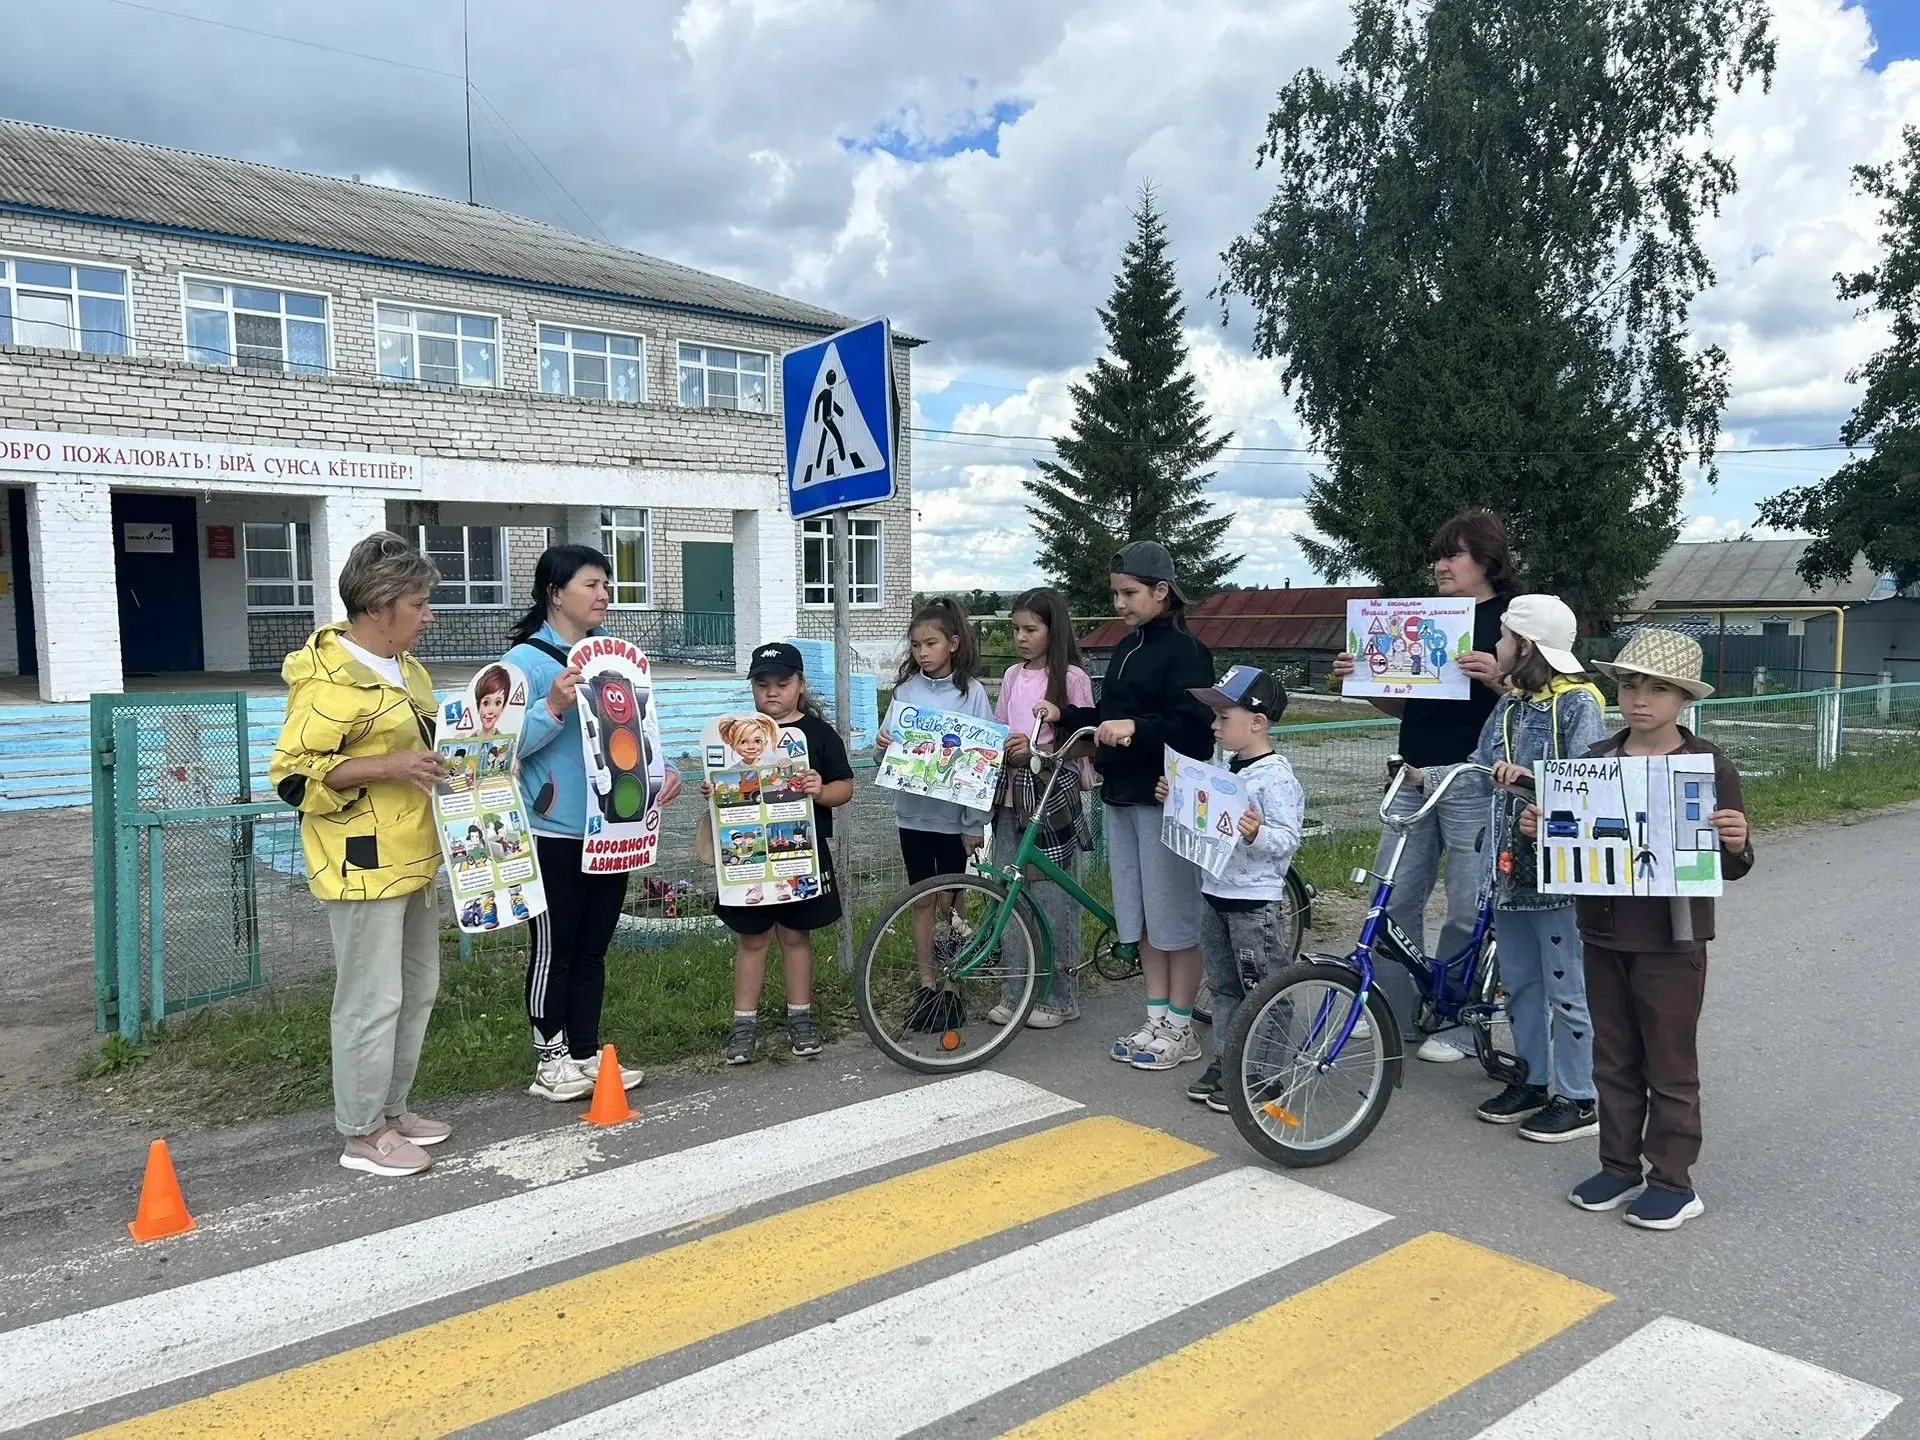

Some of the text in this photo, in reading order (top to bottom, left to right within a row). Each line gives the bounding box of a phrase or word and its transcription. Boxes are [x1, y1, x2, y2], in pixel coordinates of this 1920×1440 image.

[62, 444, 212, 469] ПОЖАЛОВАТЬ!
[264, 457, 321, 478] СУНСА
[571, 638, 648, 675] ПРАВИЛА
[1544, 760, 1620, 782] СОБЛЮДАЙ
[1553, 779, 1590, 795] ПДД
[585, 834, 656, 854] ДОРОЖНОГО
[589, 850, 650, 872] ДВИЖЕНИЯ
